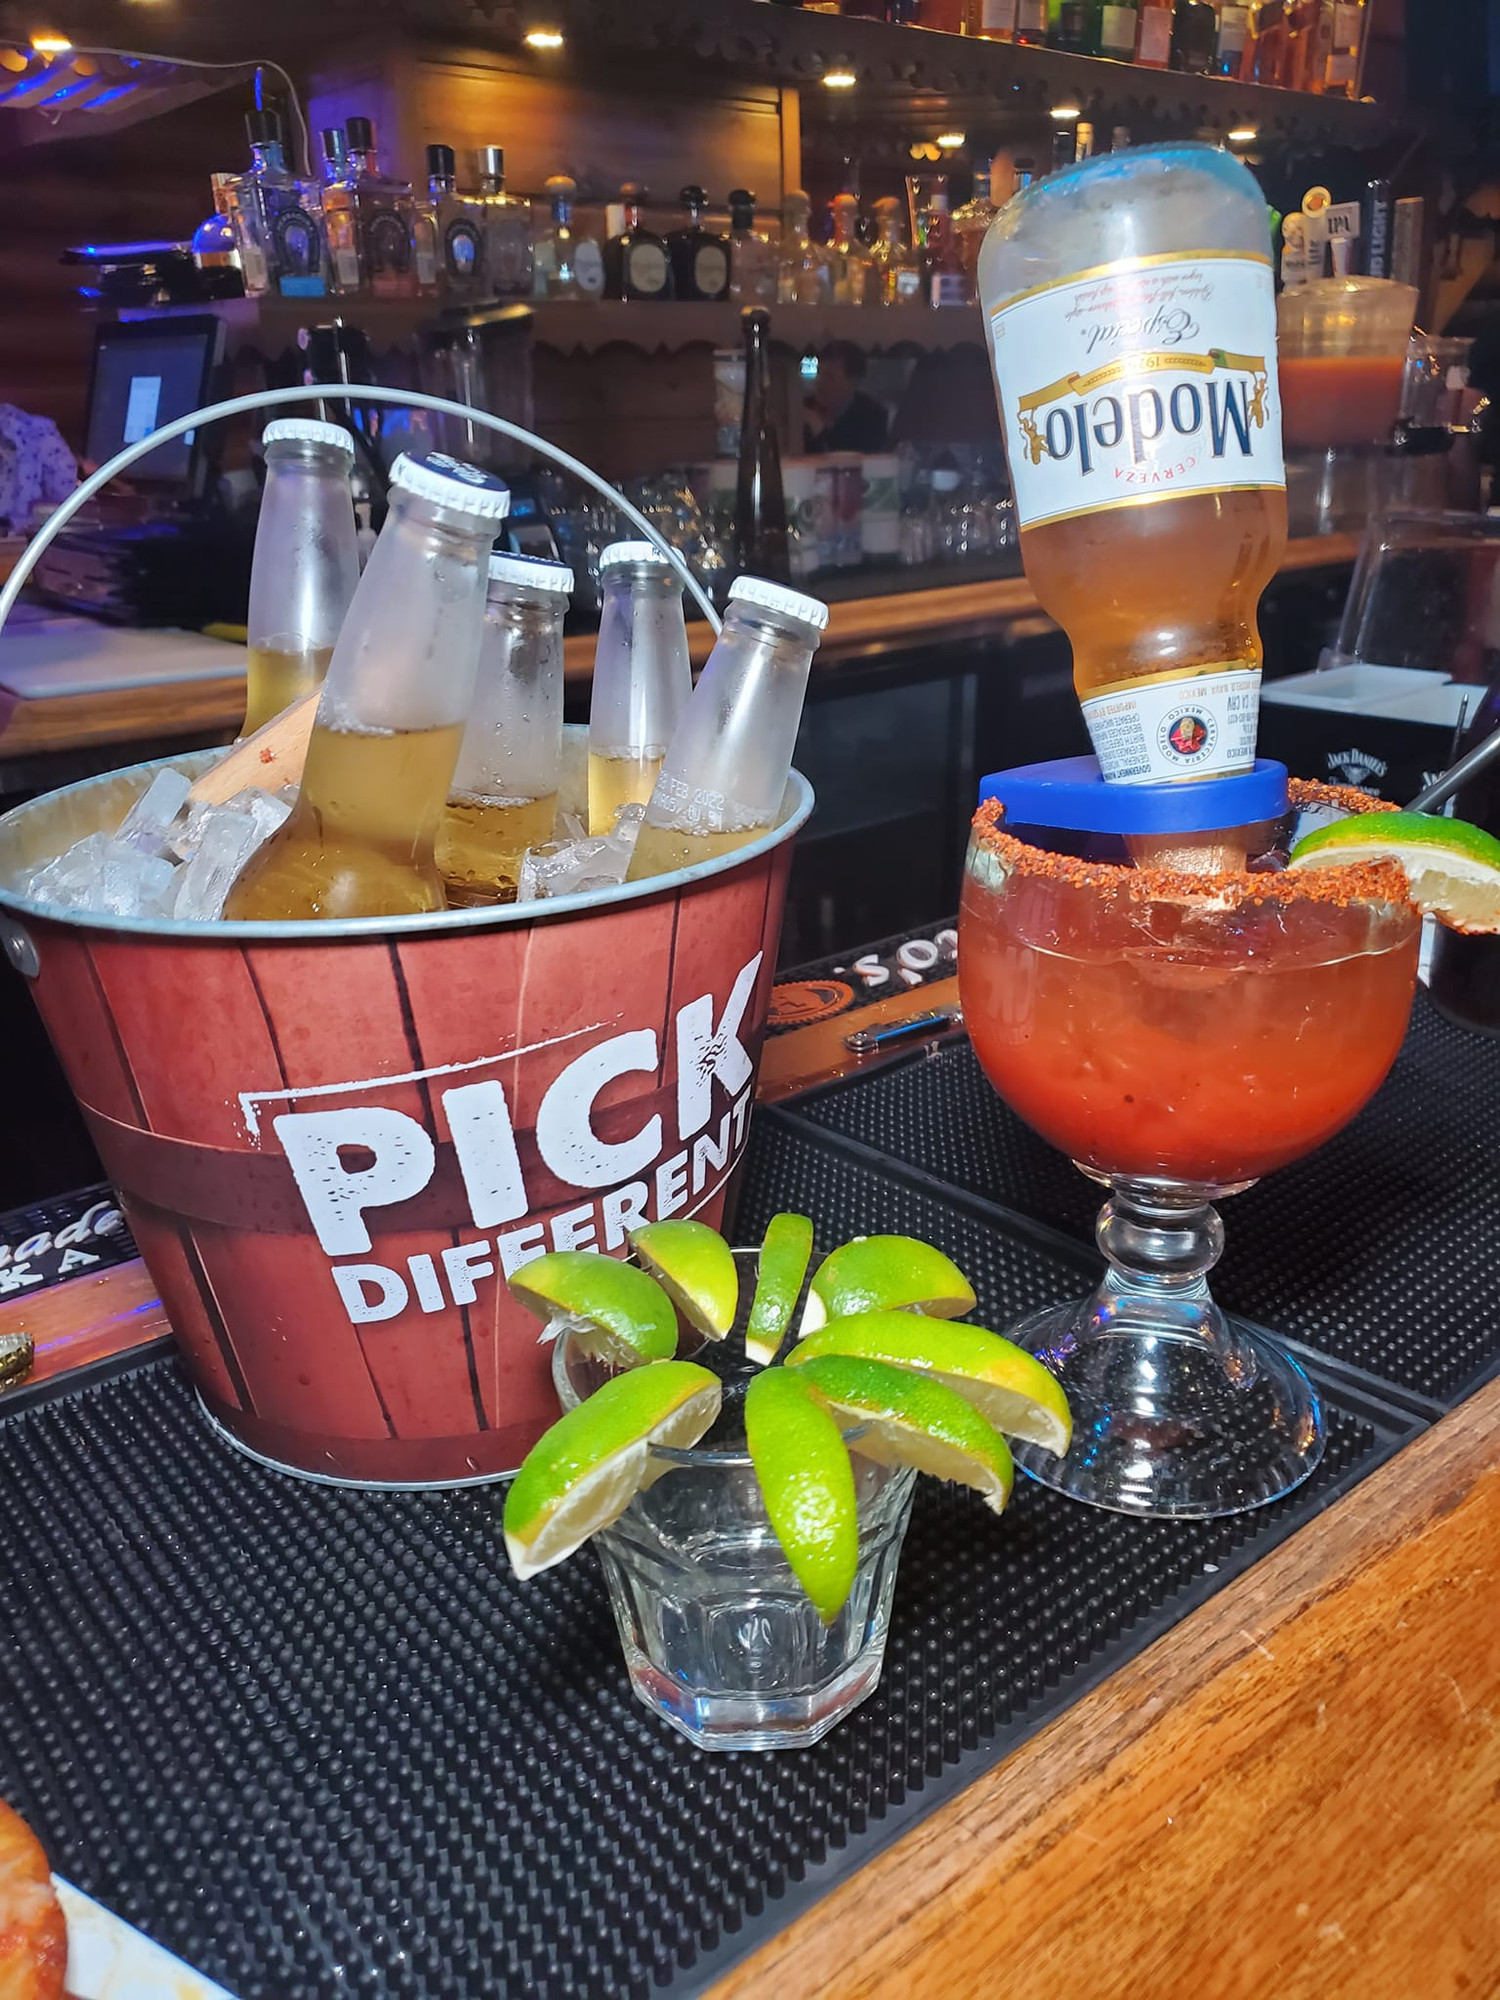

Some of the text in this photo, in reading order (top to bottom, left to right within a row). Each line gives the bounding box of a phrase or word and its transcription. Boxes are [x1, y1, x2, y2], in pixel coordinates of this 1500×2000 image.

[1328, 215, 1351, 235] IPA
[1371, 200, 1388, 255] LIGHT
[1045, 379, 1254, 477] Modelo
[1113, 456, 1197, 484] CERVEZA
[1168, 708, 1204, 721] MEXICO
[1184, 717, 1216, 764] CERVECERIA
[1327, 748, 1388, 778] JACK DANIEL'S
[669, 777, 690, 799] FEB
[272, 950, 764, 1257] PICK
[331, 1084, 753, 1324] DIFFERENT
